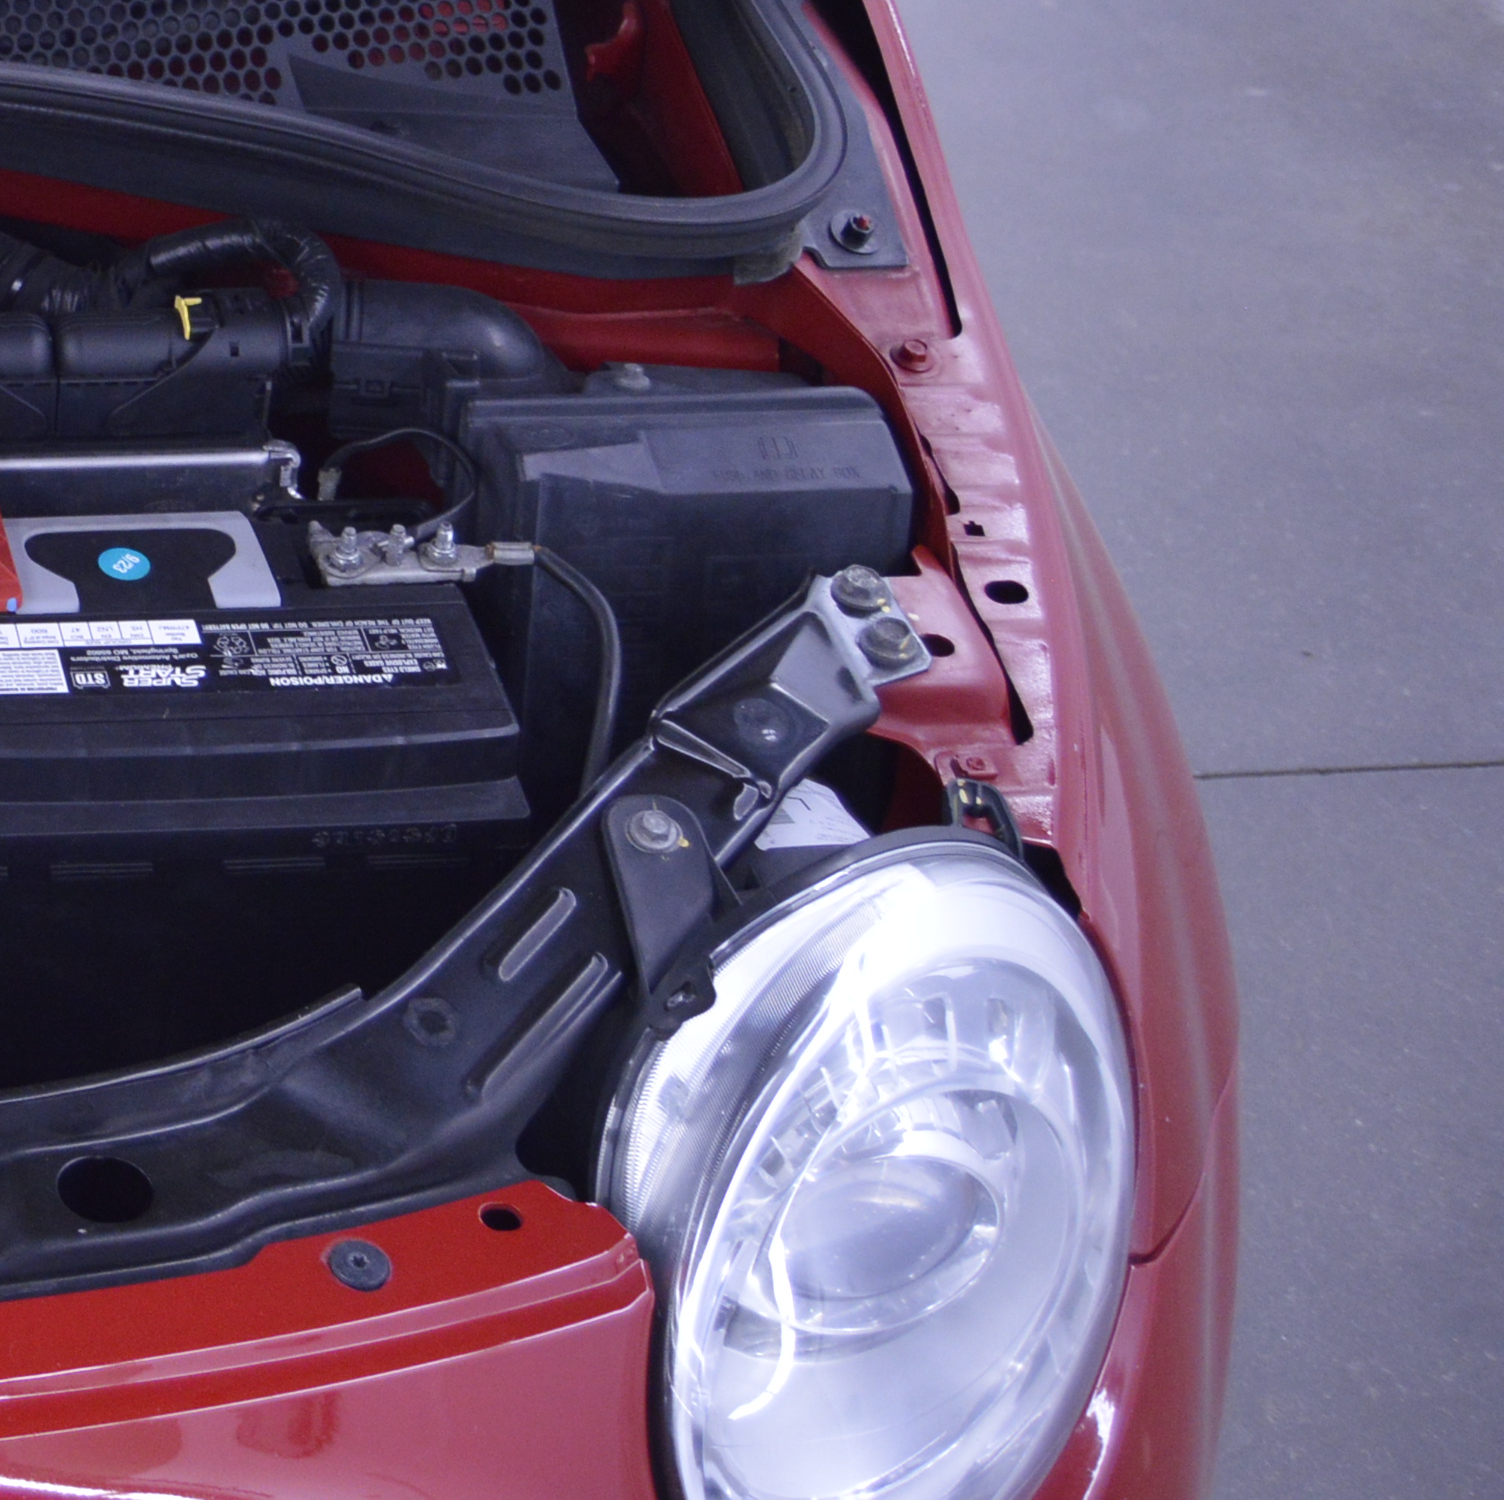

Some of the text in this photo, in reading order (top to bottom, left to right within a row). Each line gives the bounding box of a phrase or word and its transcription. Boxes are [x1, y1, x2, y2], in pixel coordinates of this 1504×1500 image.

[113, 553, 140, 573] 9/23
[70, 655, 121, 663] Distributors
[120, 665, 206, 679] START
[335, 666, 351, 674] NO
[75, 673, 106, 685] STD
[123, 677, 199, 687] SUPER
[269, 673, 383, 687] DANGER/POISON
